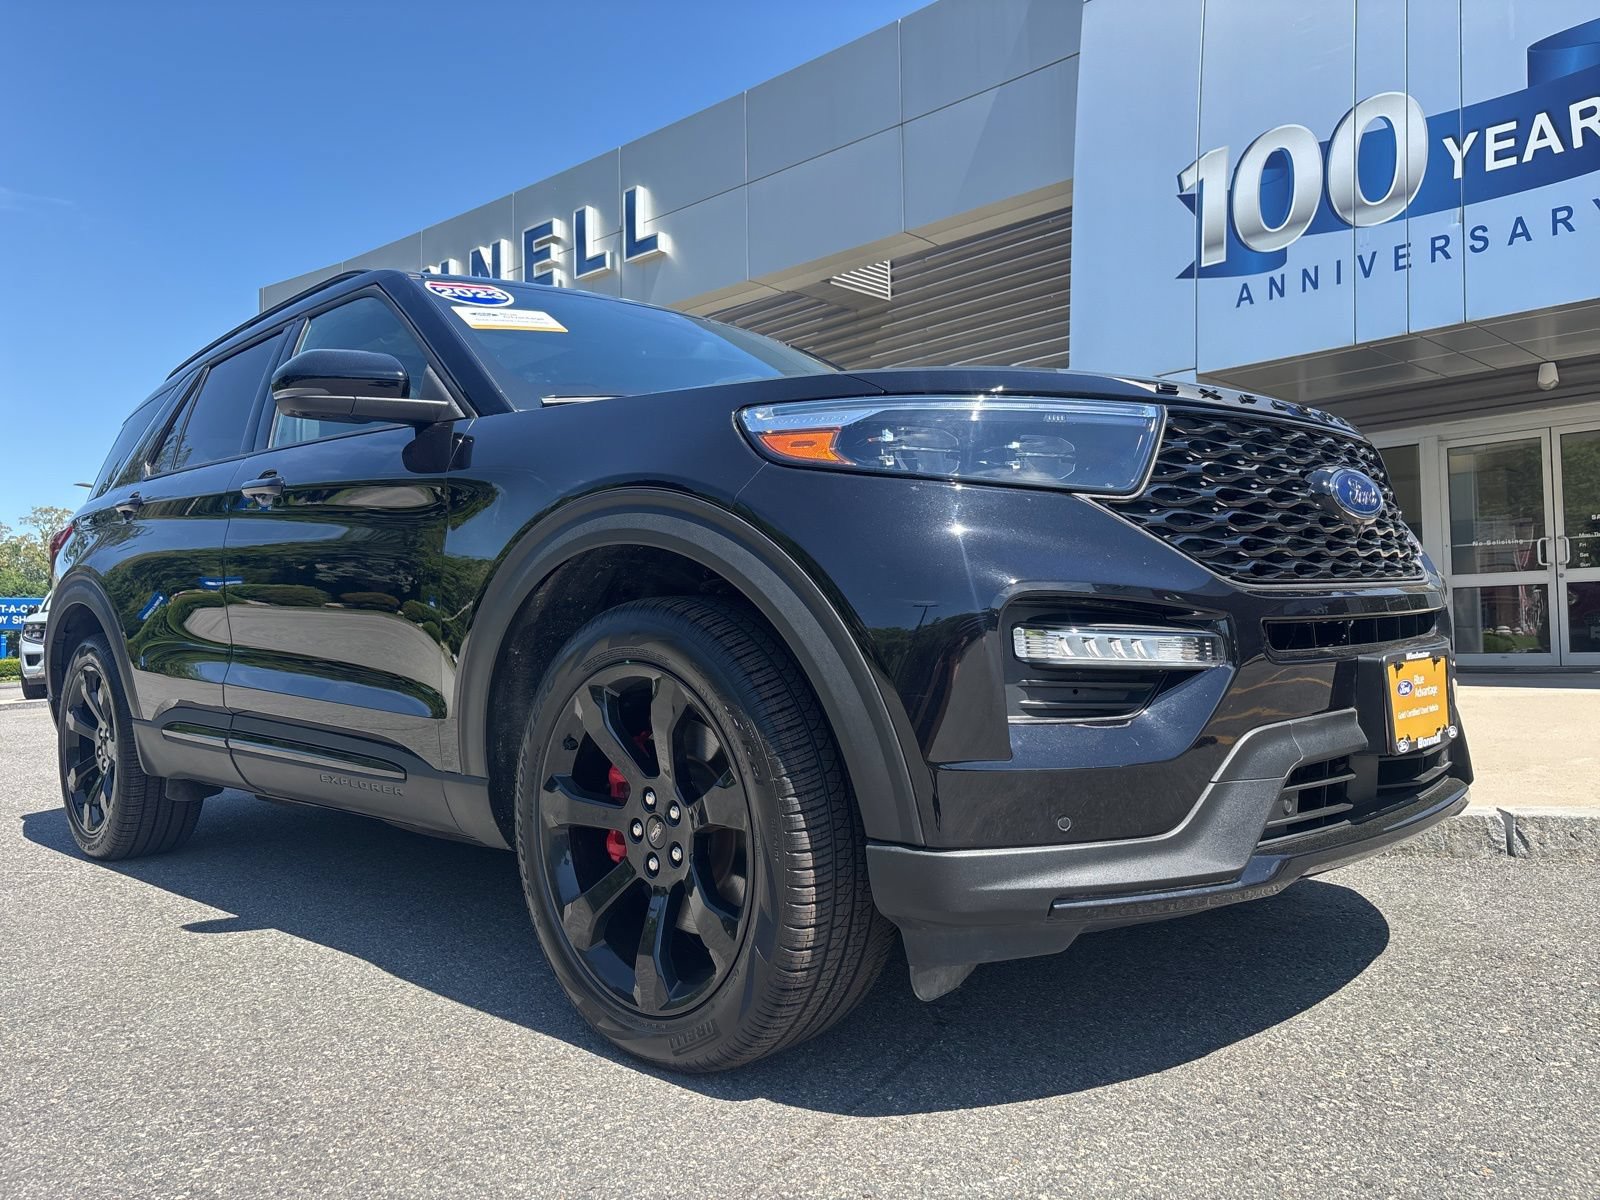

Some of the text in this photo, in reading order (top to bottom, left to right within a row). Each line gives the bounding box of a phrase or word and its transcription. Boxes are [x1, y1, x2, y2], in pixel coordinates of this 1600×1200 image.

[1176, 91, 1428, 268] 100
[422, 184, 670, 288] NELL
[1347, 477, 1378, 506] Ford
[320, 773, 404, 797] EXPLORER
